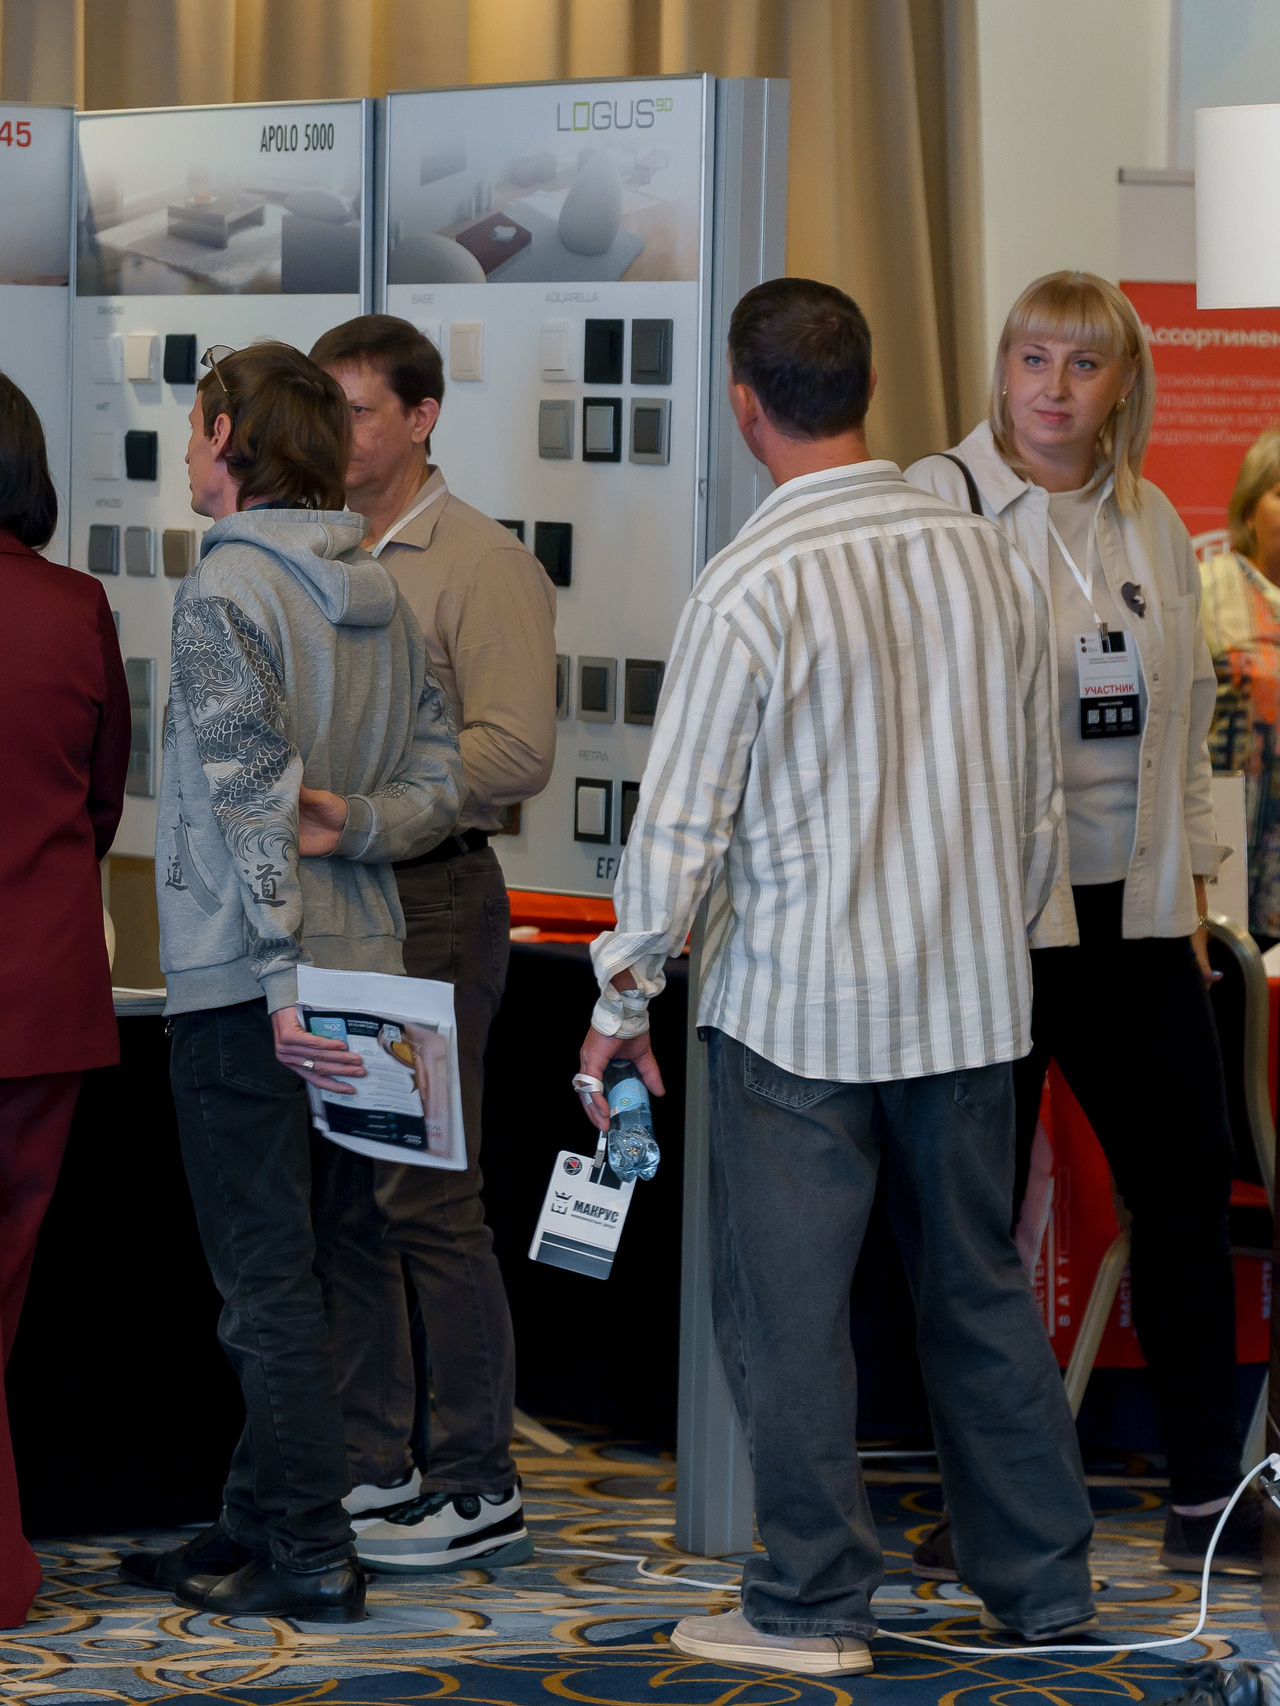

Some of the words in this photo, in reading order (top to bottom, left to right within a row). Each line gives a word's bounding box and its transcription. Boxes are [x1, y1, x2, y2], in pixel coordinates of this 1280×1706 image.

[260, 124, 298, 153] APOLO
[304, 122, 335, 152] 5000
[1084, 683, 1136, 696] УЧАСТНИК
